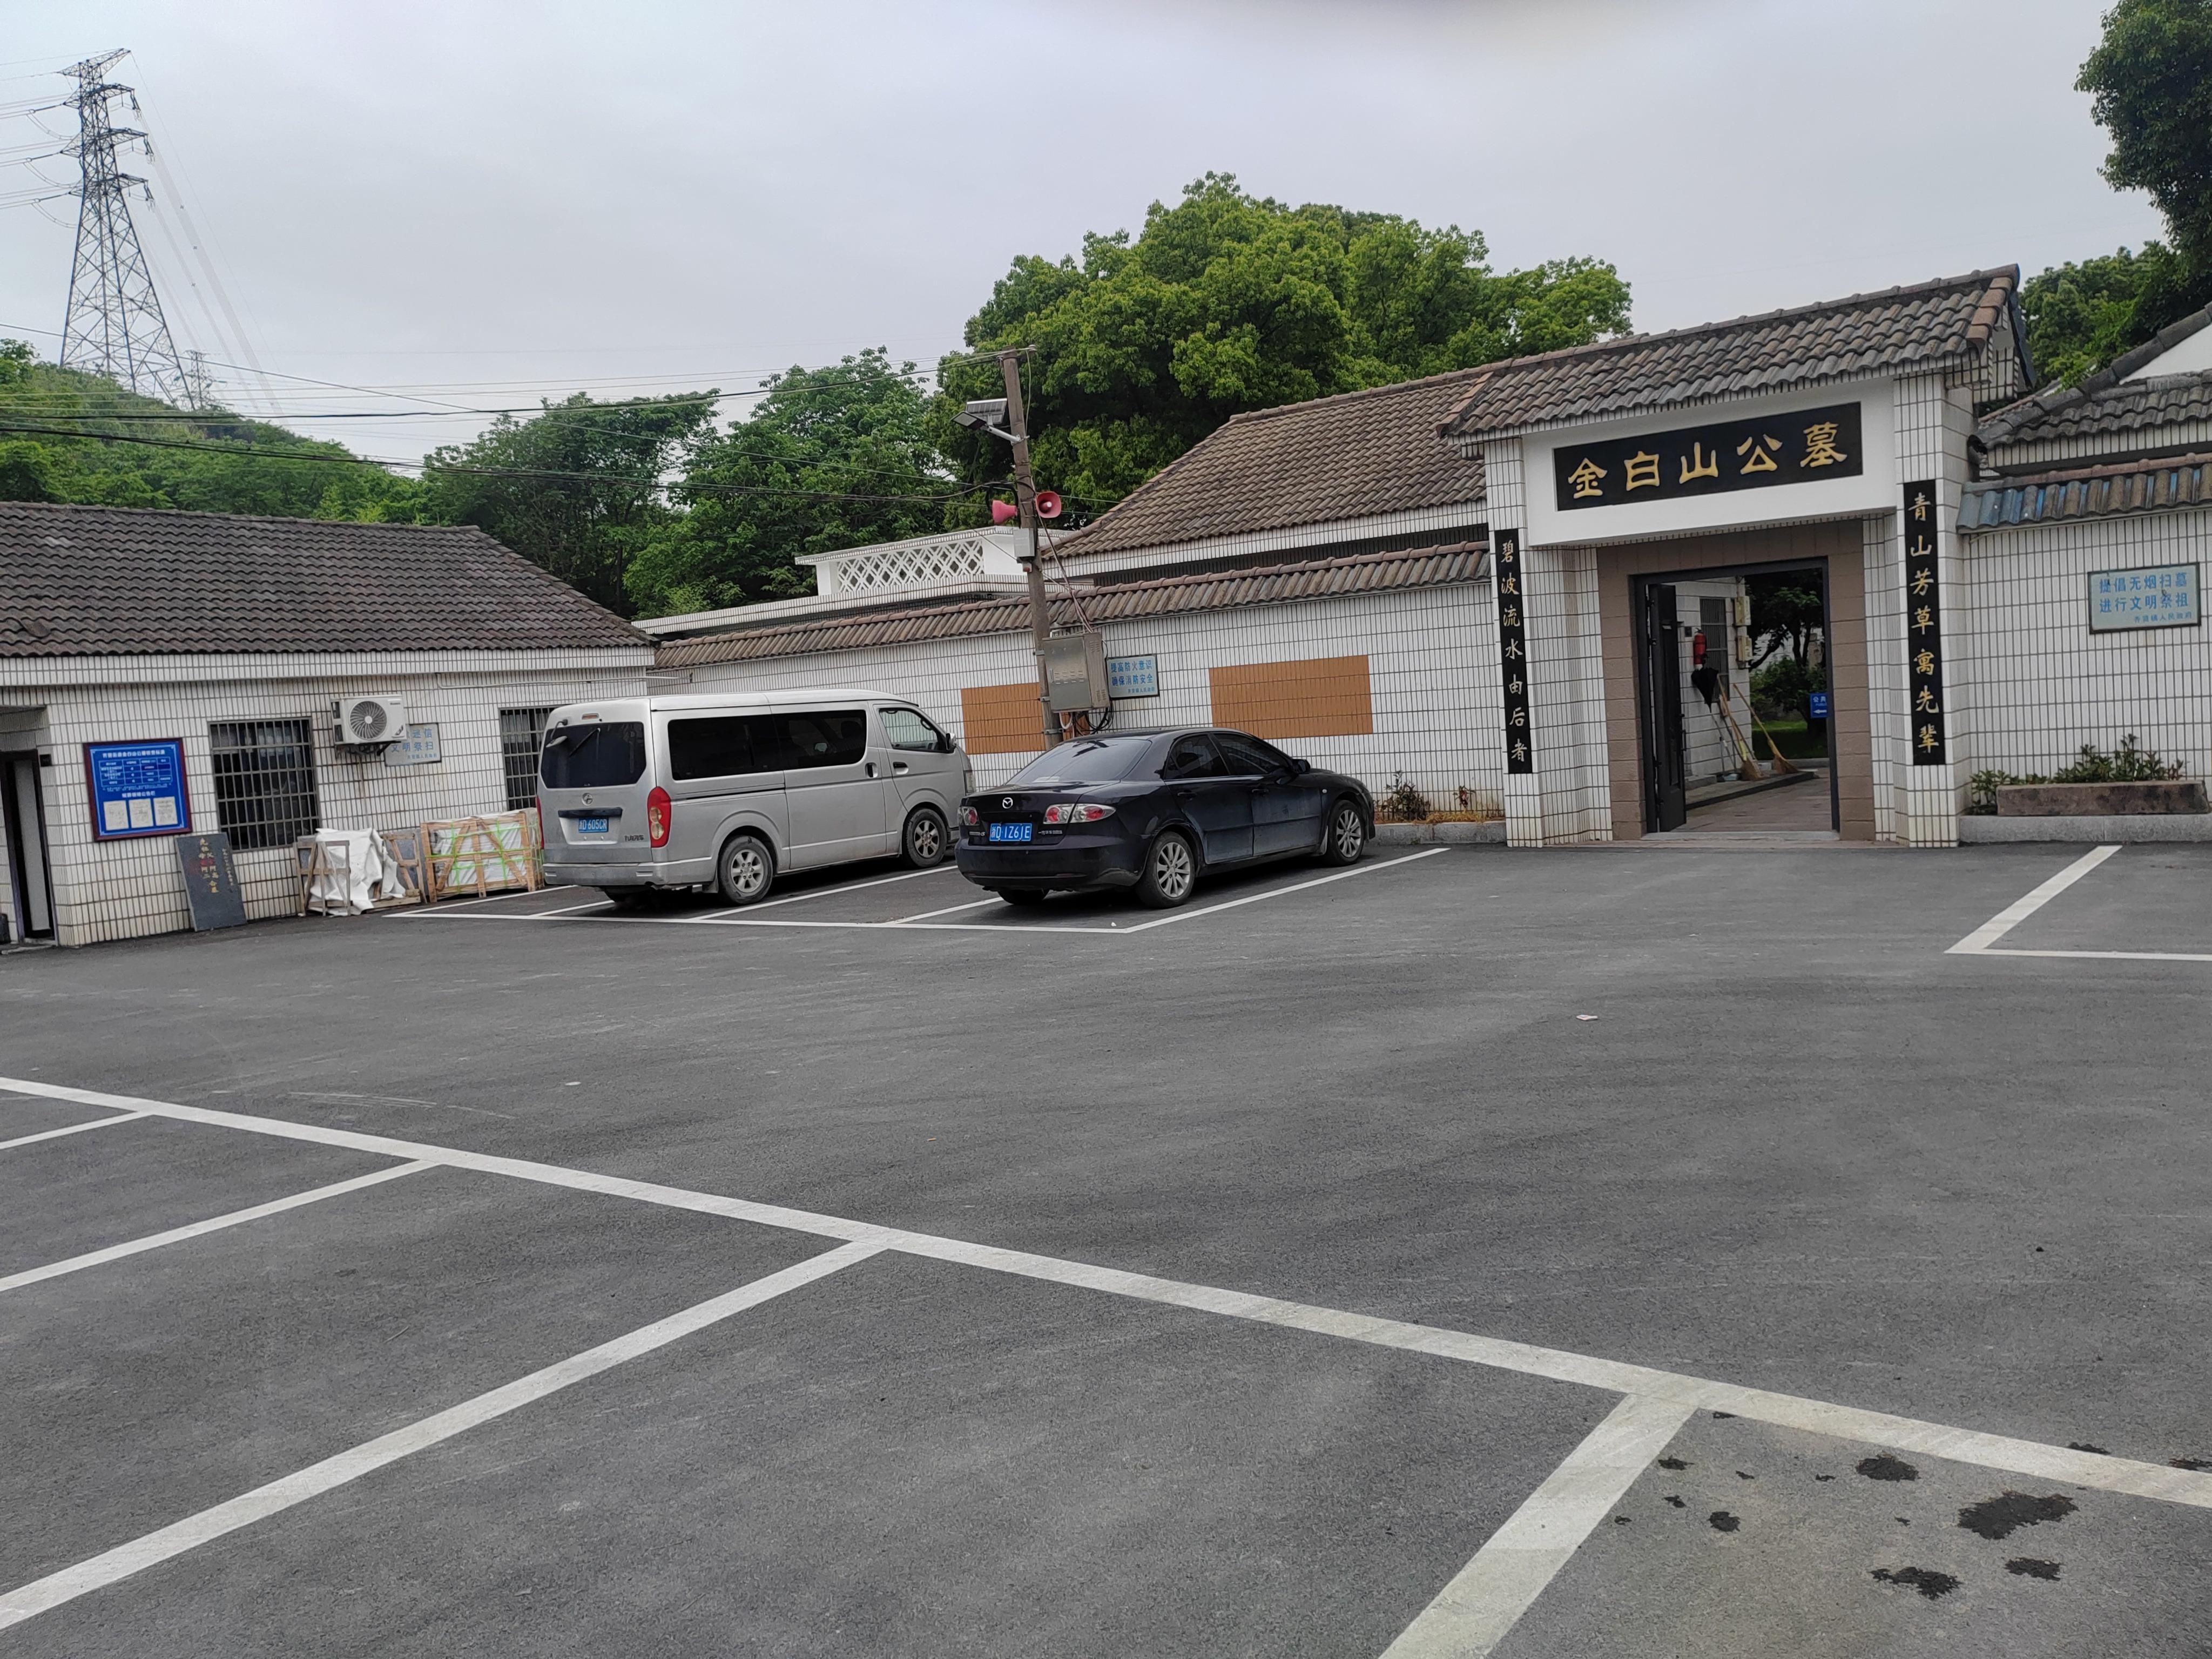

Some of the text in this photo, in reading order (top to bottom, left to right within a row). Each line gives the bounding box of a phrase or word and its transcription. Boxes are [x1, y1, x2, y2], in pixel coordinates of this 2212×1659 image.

[1568, 421, 1847, 500] 金白山公墓
[2099, 572, 2187, 594] 提倡无烟扫墓
[2099, 592, 2188, 613] 进行文明祭祖
[1110, 660, 1152, 673] 提高防火意识
[1111, 673, 1153, 686] 确保消防安全
[406, 728, 432, 739] 迷信
[391, 741, 434, 753] 文明祭扫
